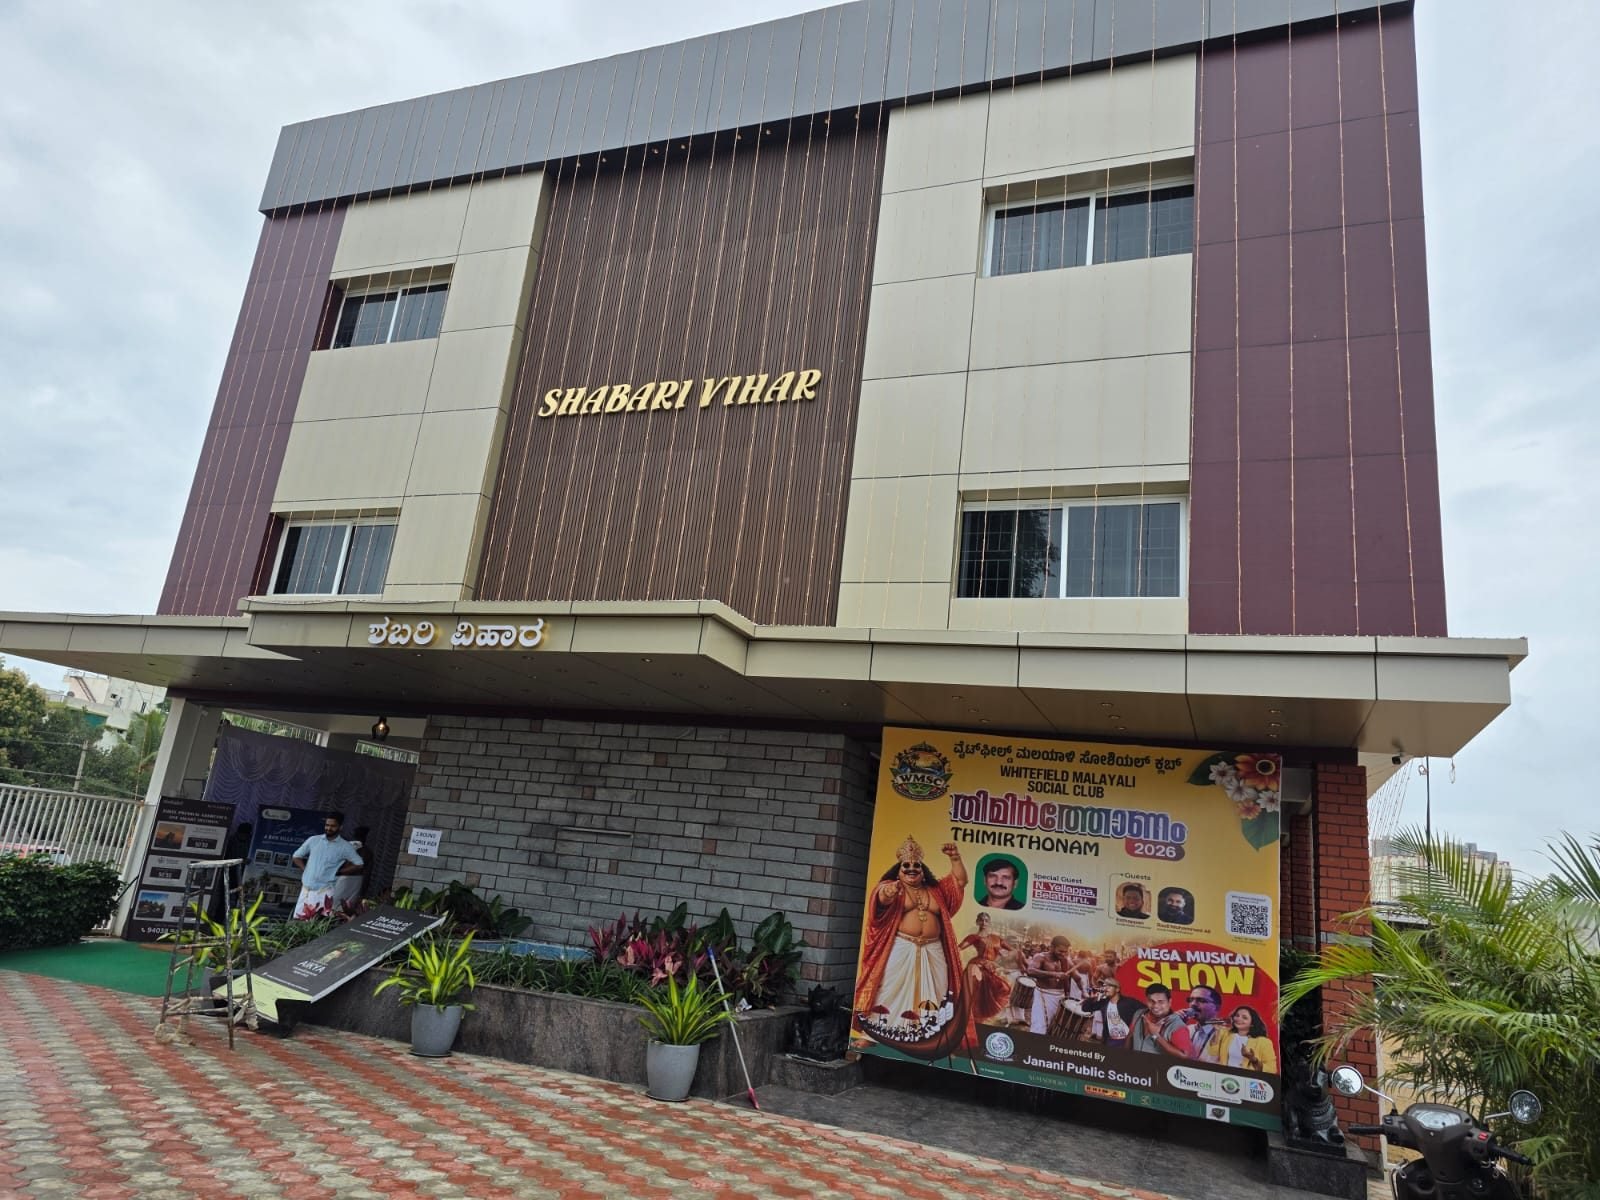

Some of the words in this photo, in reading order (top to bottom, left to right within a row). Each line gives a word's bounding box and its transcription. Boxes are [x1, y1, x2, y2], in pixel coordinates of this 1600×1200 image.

[538, 380, 693, 417] SHABARI
[700, 369, 822, 408] VIHAR
[368, 616, 435, 645] ಶಬರಿ
[451, 618, 544, 647] ವಿಹಾರ
[1016, 746, 1076, 763] ಮಲಯಾಳಿ
[899, 773, 943, 787] WMSC
[1000, 765, 1069, 782] WHITEFIELD
[1072, 770, 1136, 788] MALAYALI
[1027, 780, 1070, 796] SOCIAL
[1073, 784, 1105, 798] CLUB
[950, 827, 1099, 856] THIMIRTHONAM
[1134, 841, 1177, 858] 2026
[1033, 872, 1059, 881] Special
[1061, 876, 1082, 884] Guest
[1035, 881, 1047, 890] N.
[1124, 872, 1151, 881] Guests
[1138, 947, 1182, 962] MEGA
[1186, 950, 1255, 966] MUSICAL
[1136, 961, 1255, 995] SHOW
[1049, 1044, 1093, 1059] Presented
[1094, 1051, 1106, 1062] By
[1023, 1055, 1064, 1071] Janani
[1066, 1062, 1105, 1078] Public
[1108, 1069, 1152, 1087] School
